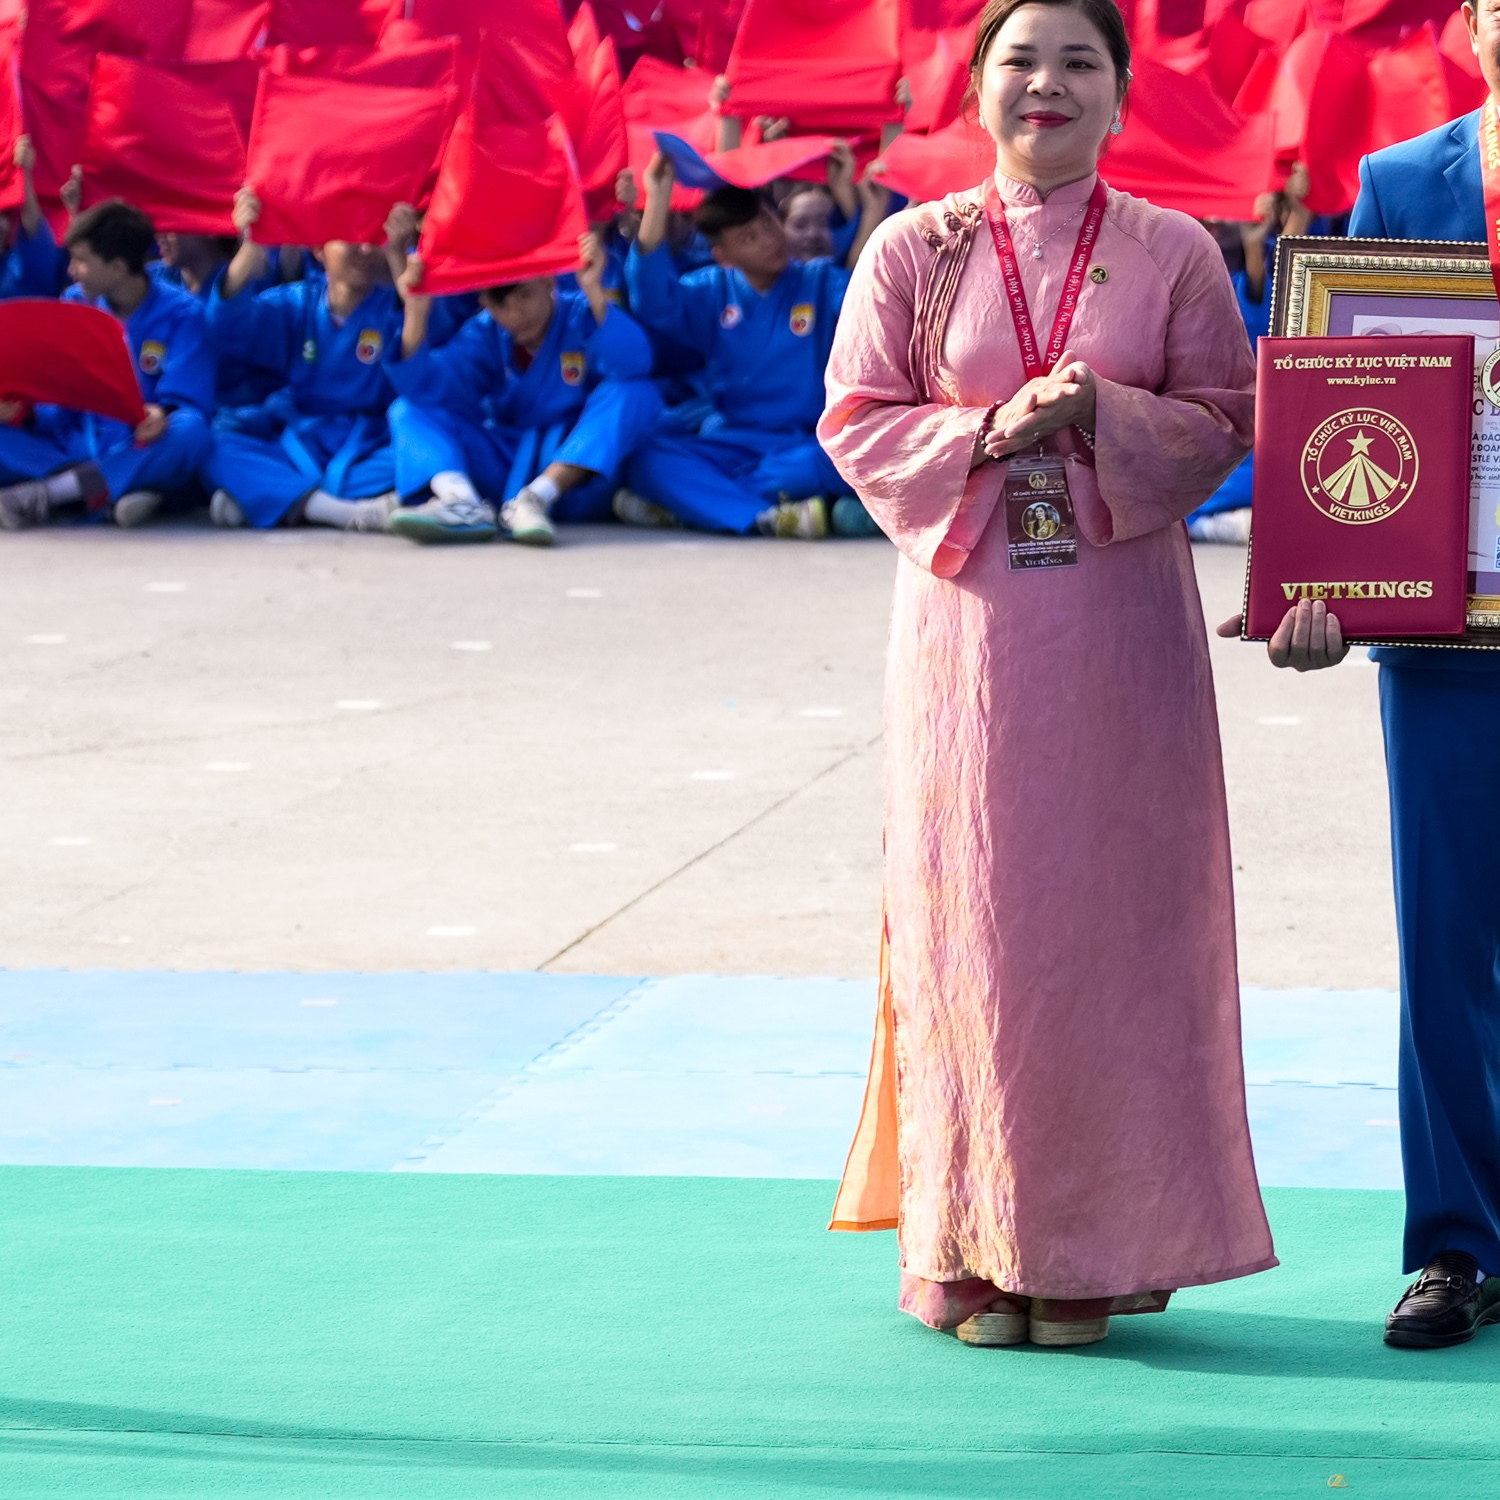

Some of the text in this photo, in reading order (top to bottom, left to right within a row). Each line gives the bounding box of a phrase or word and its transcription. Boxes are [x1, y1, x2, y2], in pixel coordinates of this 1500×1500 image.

[1274, 354, 1452, 370] TỔ CHỨC KỶ LỤC VIỆT NAM
[1327, 376, 1396, 387] www.kyluc.vn
[1314, 420, 1340, 447] CHỨC
[1357, 413, 1379, 425] LỤC
[1379, 418, 1401, 437] VIỆT
[1397, 434, 1413, 461] NAM
[1472, 454, 1490, 463] STLÉ
[1329, 502, 1391, 520] VIETKINGS
[1281, 581, 1433, 600] VIETKINGS
